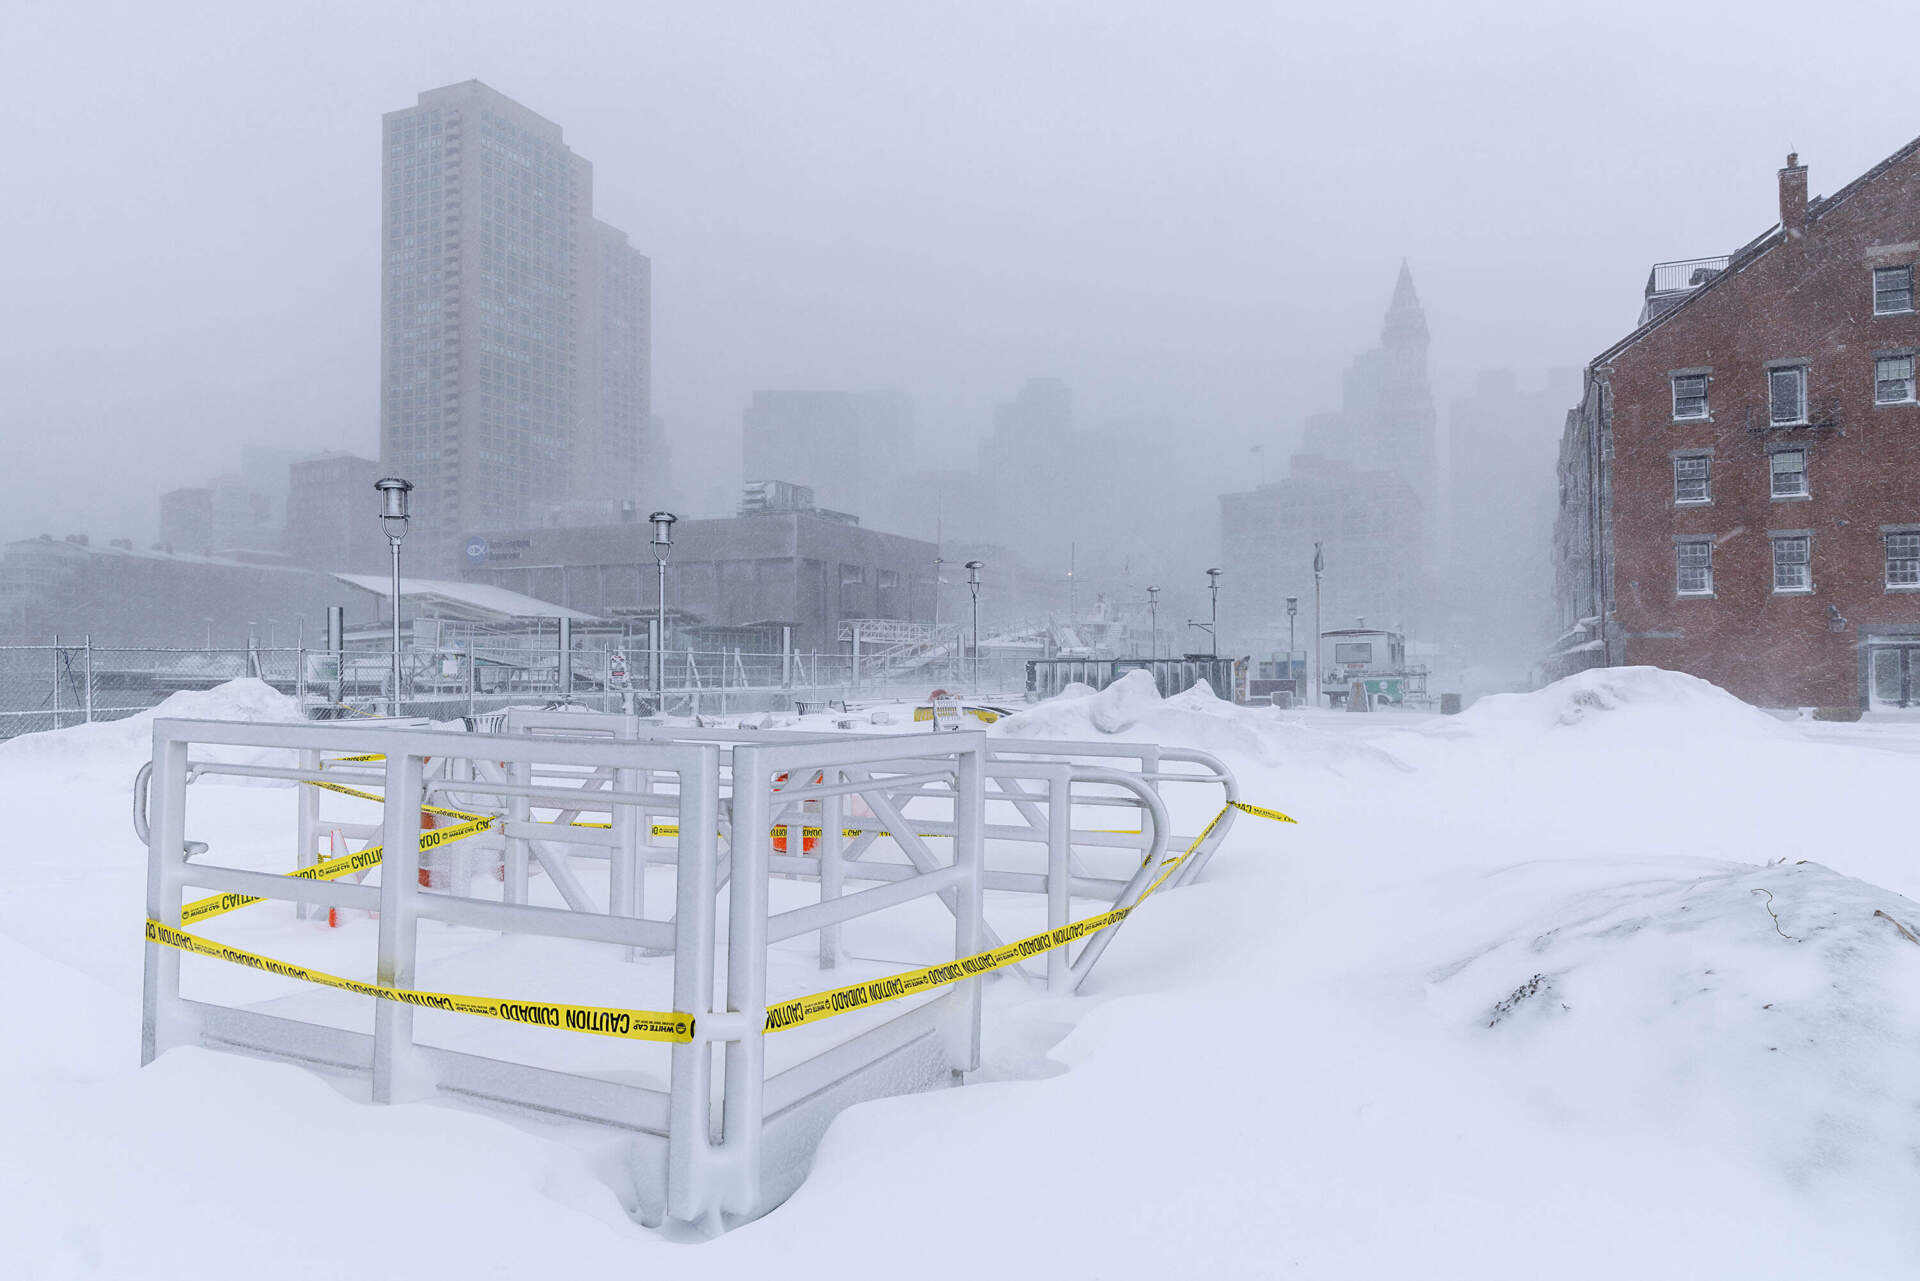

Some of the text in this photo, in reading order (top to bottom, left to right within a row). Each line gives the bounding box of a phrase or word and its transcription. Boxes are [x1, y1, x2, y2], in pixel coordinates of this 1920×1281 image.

[158, 926, 194, 952] CAUTION
[1018, 923, 1084, 957] CAUTION CUIDADO
[222, 948, 266, 972] CUIDADO
[265, 961, 312, 982] CAUTION
[928, 953, 997, 984] CAUTION CUIDADO
[345, 982, 399, 1002] CUIDADO
[398, 992, 455, 1012] CAUTION
[831, 977, 905, 1011] CAUTION CUIDADO
[499, 1003, 631, 1034] CAUTION CUIDADO
[632, 1023, 649, 1031] CAP
[649, 1022, 675, 1034] WHITE
[765, 1002, 804, 1030] CAUTION
